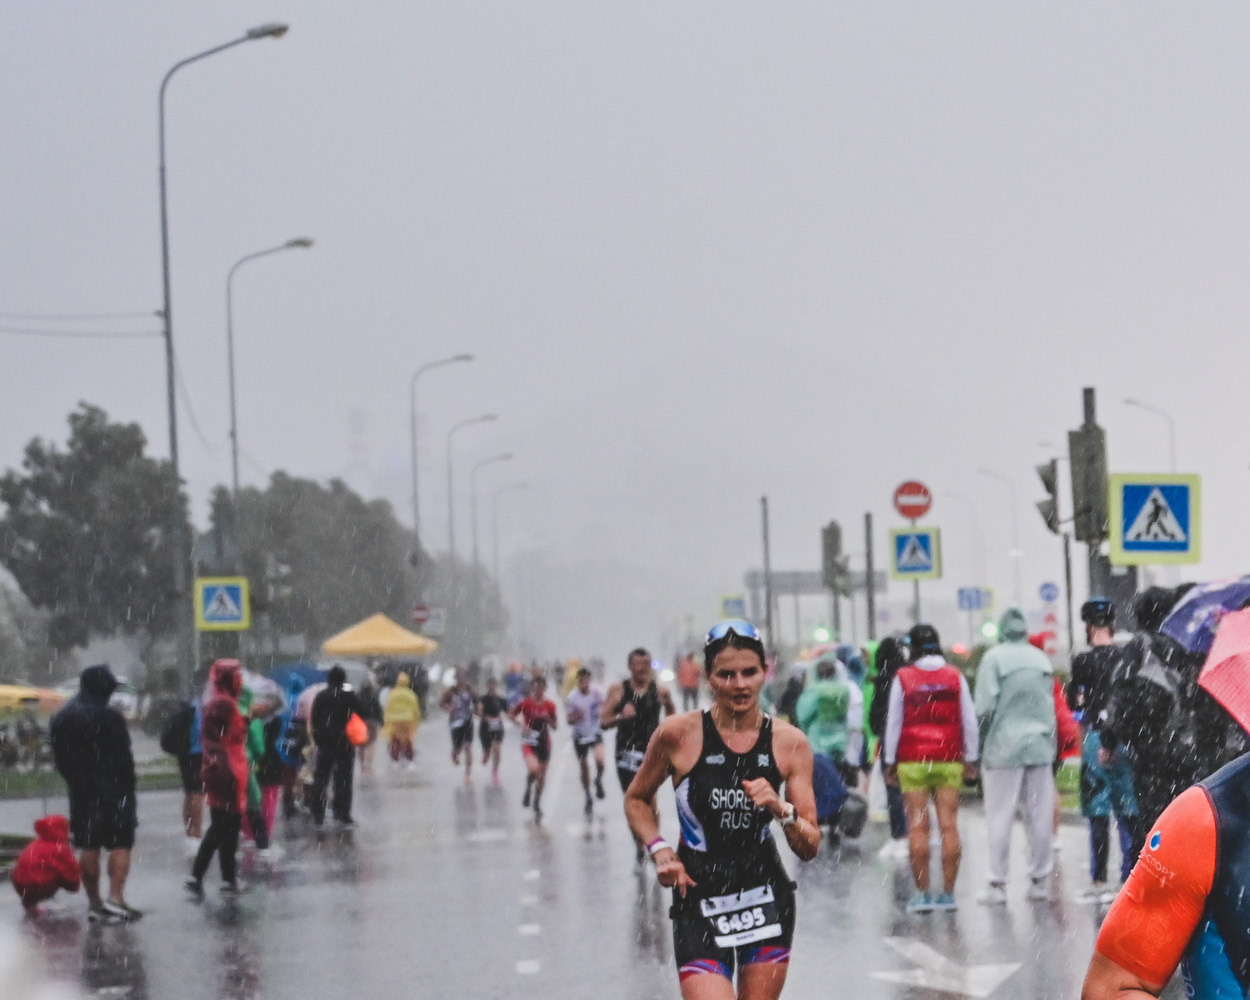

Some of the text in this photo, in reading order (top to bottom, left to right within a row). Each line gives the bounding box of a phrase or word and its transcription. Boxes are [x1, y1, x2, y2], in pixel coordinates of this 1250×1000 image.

[711, 787, 765, 811] SHORE
[720, 811, 752, 829] RUS
[717, 906, 766, 935] 6495
